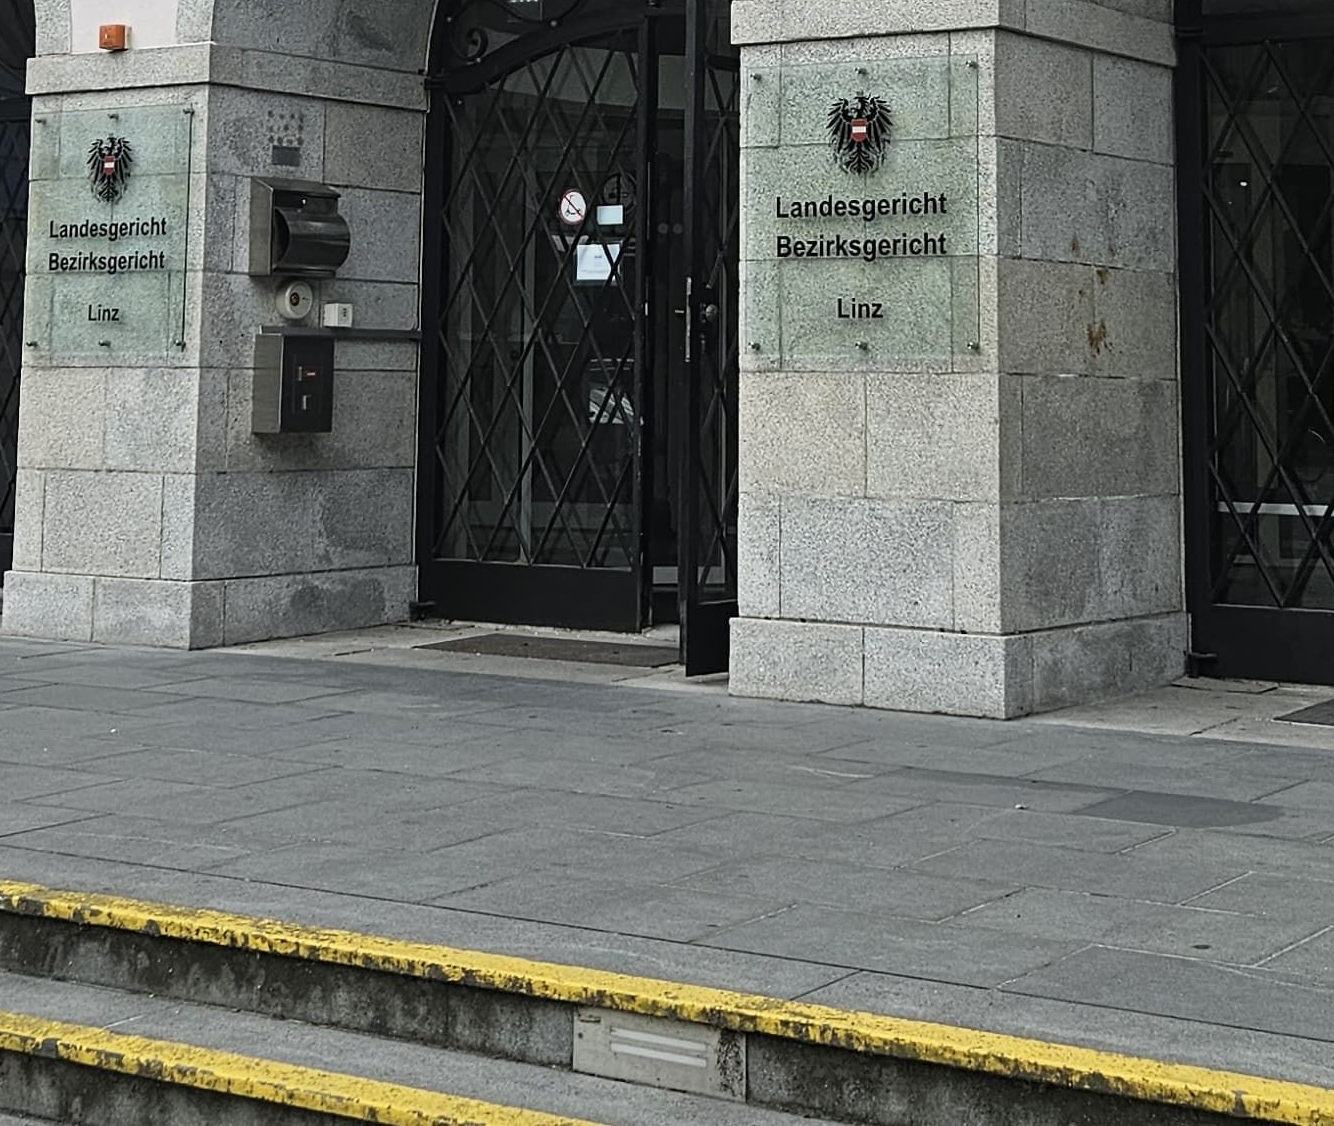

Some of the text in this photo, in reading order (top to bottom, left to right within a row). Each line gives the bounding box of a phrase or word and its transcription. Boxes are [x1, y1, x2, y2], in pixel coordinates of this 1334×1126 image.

[776, 191, 948, 222] Landesgericht
[49, 216, 167, 241] Landesgericht
[776, 232, 948, 262] Bezirksgericht
[48, 250, 165, 274] Bezirksgericht
[87, 304, 119, 322] Linz
[837, 297, 884, 319] Linz
